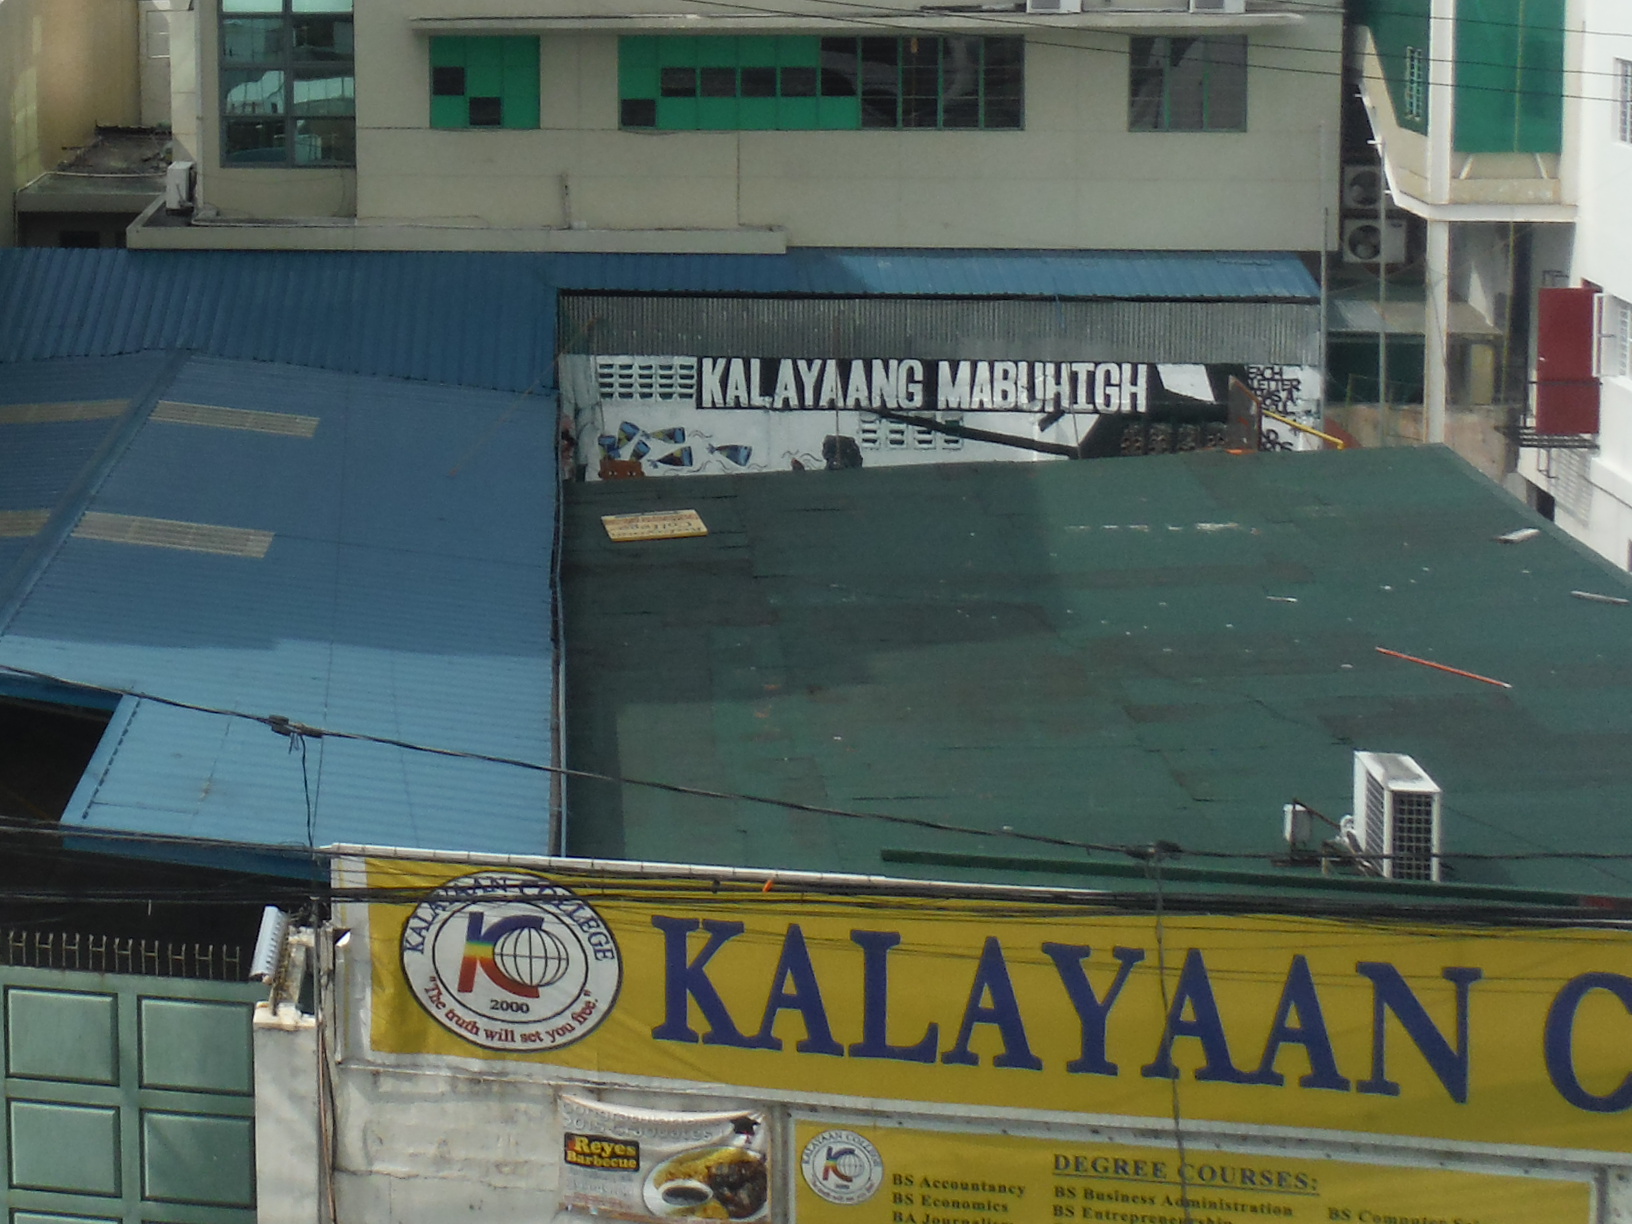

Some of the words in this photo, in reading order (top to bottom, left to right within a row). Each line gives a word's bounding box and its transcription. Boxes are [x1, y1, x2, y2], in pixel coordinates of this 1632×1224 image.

[701, 357, 924, 409] KALAYAANG
[490, 999, 530, 1014] 2000
[650, 912, 1482, 1105] KALAYAAN
[445, 1007, 480, 1037] truth
[484, 1026, 516, 1043] will
[520, 1031, 543, 1044] set
[548, 1023, 576, 1044] you
[574, 1137, 637, 1158] Reyes
[567, 1150, 637, 1169] Barbecue
[1053, 1154, 1167, 1178] DEGREE
[1178, 1163, 1318, 1191] COURSES:
[892, 1173, 915, 1187] BS
[920, 1176, 1026, 1198] Accountancy
[1054, 1185, 1077, 1199] BS
[1083, 1187, 1156, 1206] Business
[892, 1192, 915, 1206] BS
[921, 1194, 1009, 1213] Economics
[1053, 1204, 1075, 1218] BS
[893, 1210, 916, 1224] BA
[1328, 1207, 1352, 1221] BS
